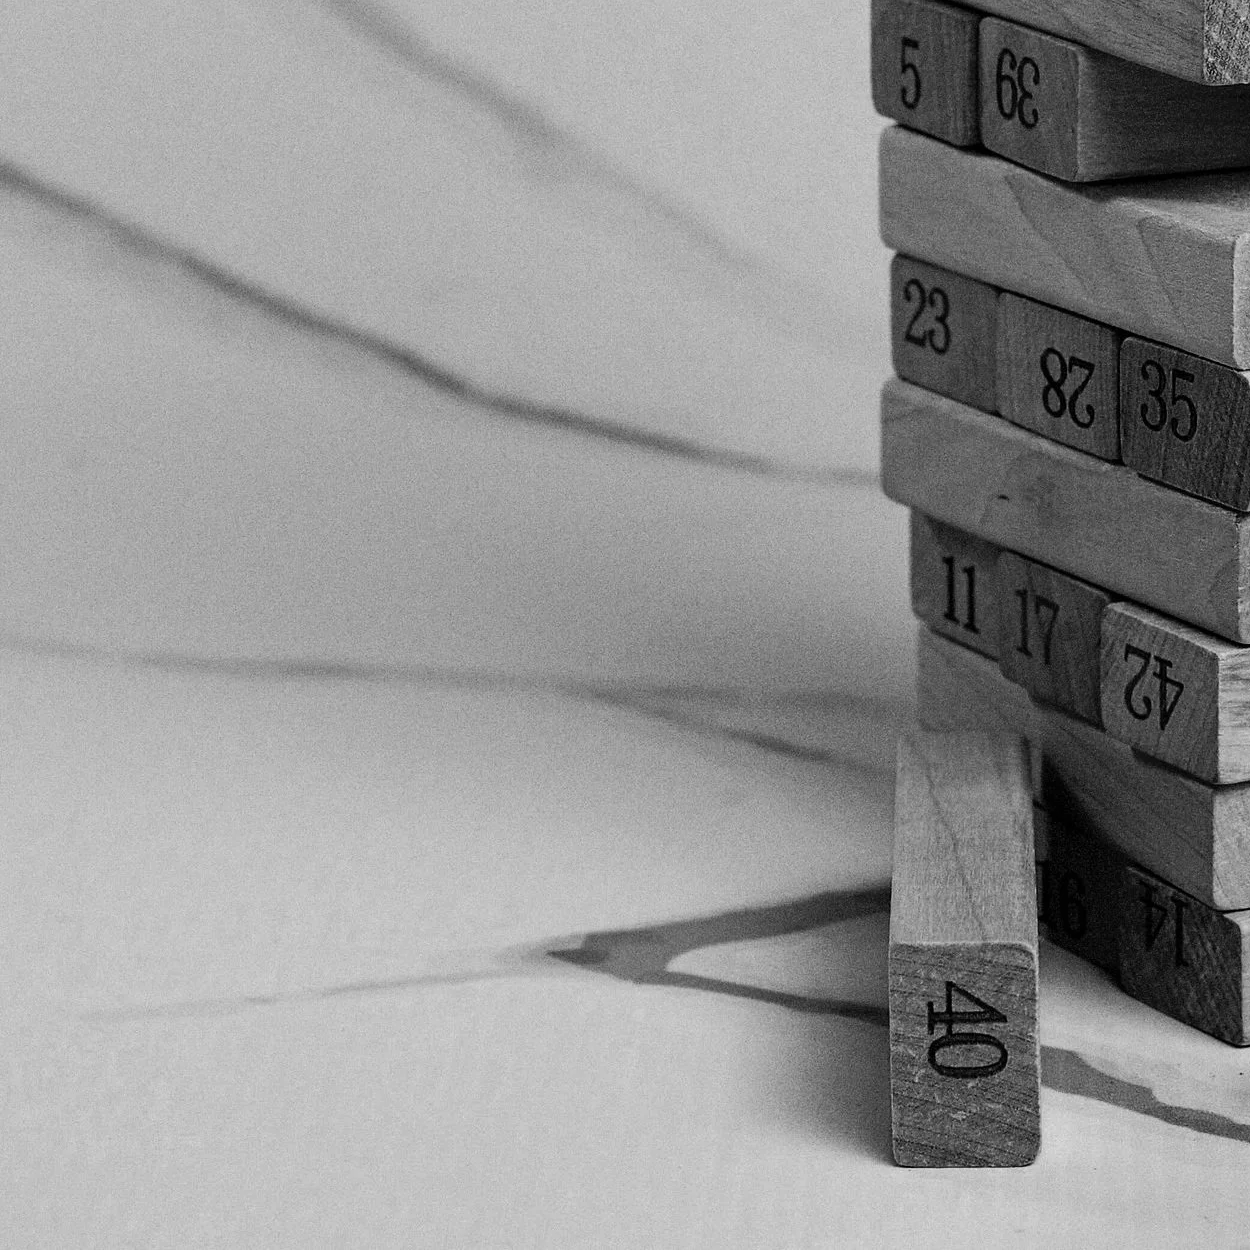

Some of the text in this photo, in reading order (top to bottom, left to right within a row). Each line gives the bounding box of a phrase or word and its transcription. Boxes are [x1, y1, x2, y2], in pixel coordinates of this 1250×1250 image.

[900, 39, 922, 110] 5
[995, 47, 1040, 129] 39
[902, 278, 950, 355] 23
[1039, 346, 1096, 429] 28
[1139, 360, 1199, 441] 35
[942, 555, 978, 634] 11
[1014, 588, 1060, 661] 17
[1122, 644, 1185, 730] 42
[1139, 880, 1188, 967] 14
[927, 981, 1008, 1079] 40
